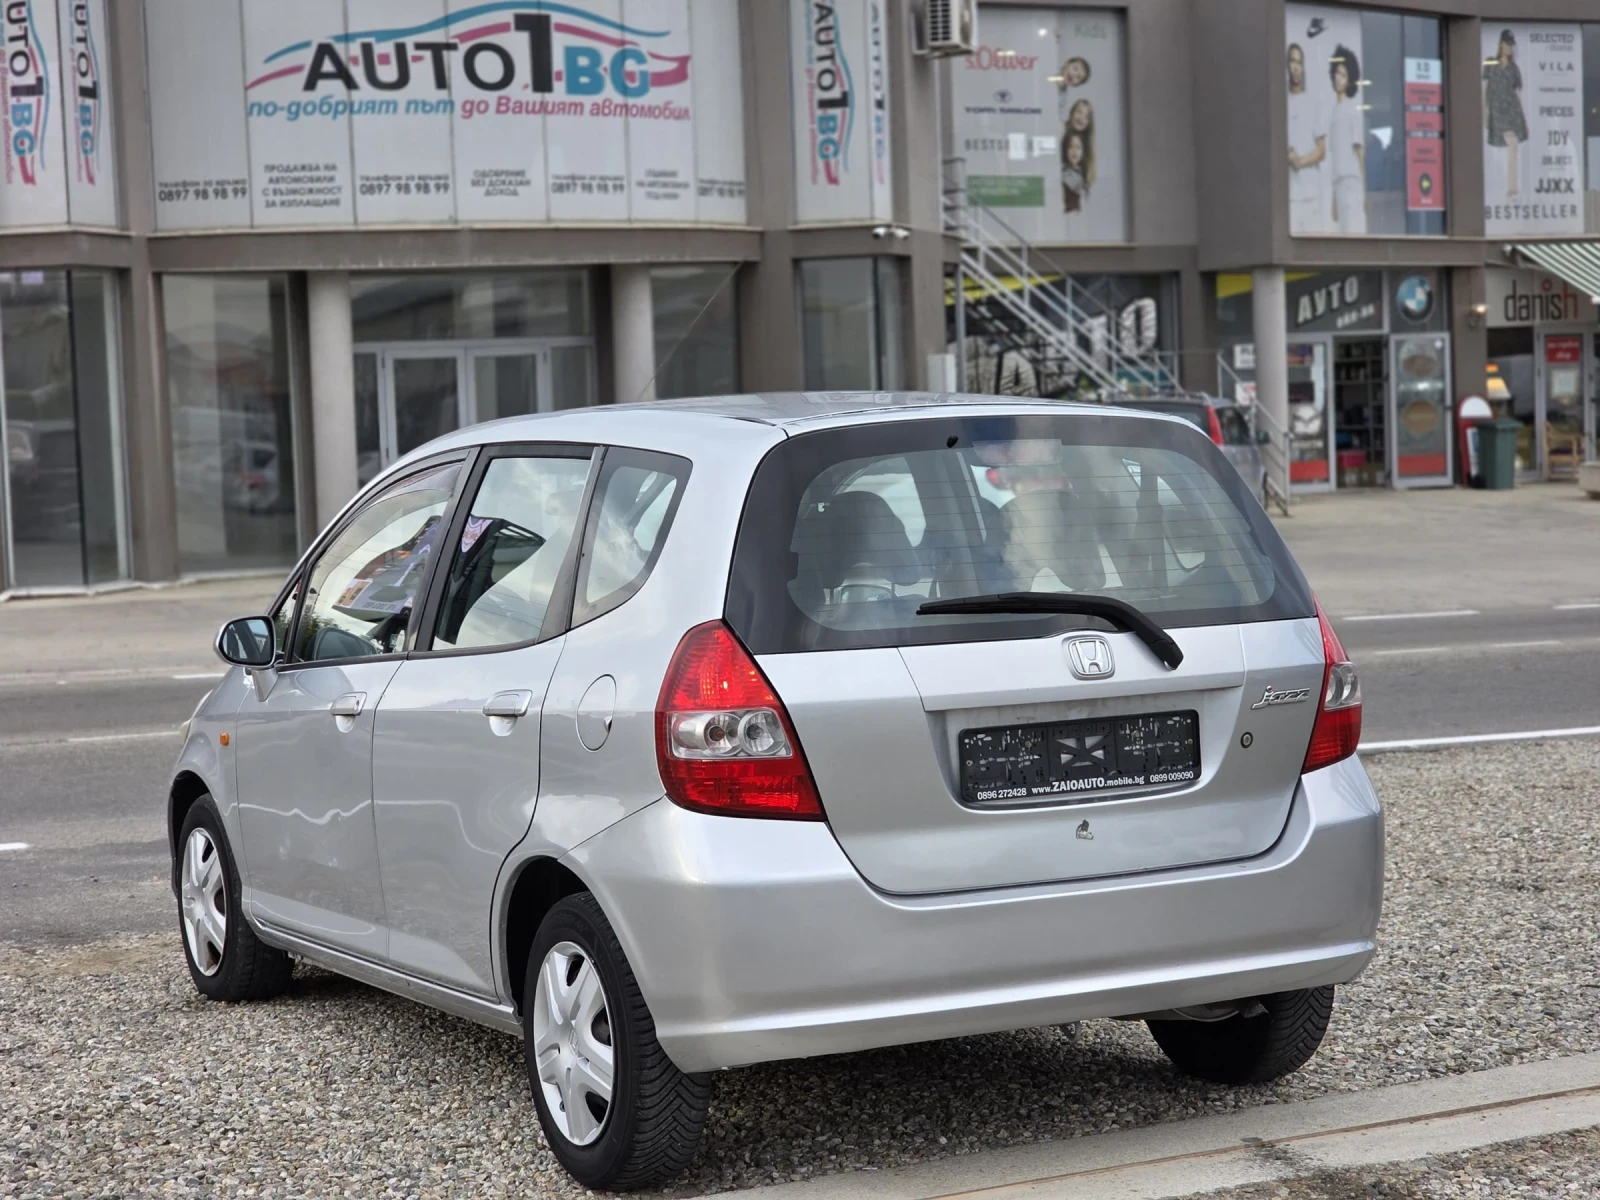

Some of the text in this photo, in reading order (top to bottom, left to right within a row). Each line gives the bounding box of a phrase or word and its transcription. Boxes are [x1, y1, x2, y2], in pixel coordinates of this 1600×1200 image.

[1539, 62, 1574, 71] VILA
[7, 0, 44, 157] UTO1BG
[248, 94, 691, 121] по-добрият път до Вашият автомобил
[1539, 105, 1575, 117] PIECES
[359, 182, 450, 196] 0897 98 98 99
[1535, 178, 1575, 194] JJXX
[158, 187, 247, 202] 0897 98 98 99
[1484, 204, 1577, 220] BESTSELLER
[1504, 279, 1578, 322] danish
[977, 771, 1194, 800] 0896 272428 www.ZAIOAUTO.mobile.bg 0899 009090
